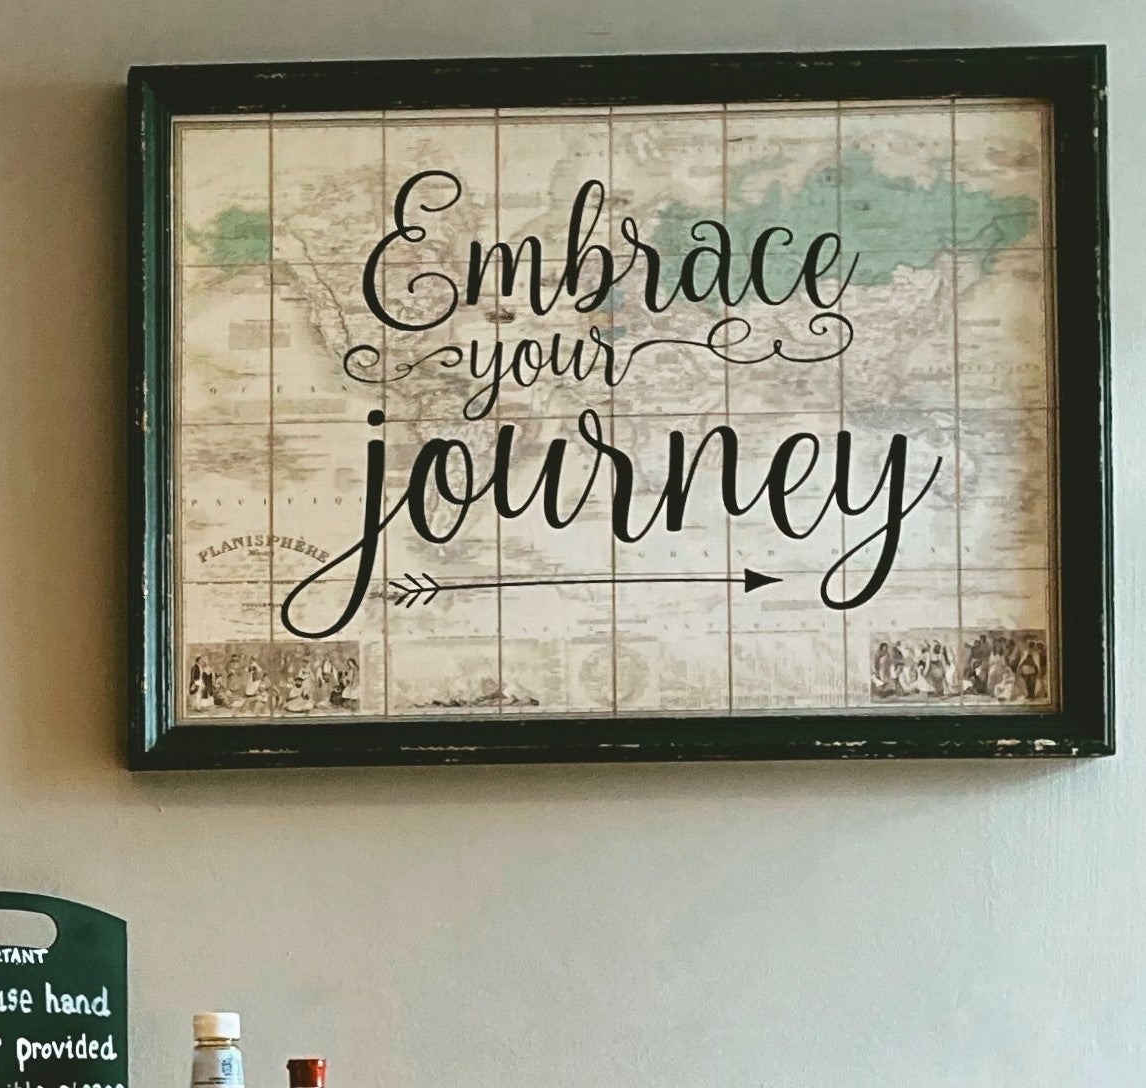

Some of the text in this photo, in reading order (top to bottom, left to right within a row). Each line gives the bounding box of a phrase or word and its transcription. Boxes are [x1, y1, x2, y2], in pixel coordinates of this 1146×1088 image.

[363, 170, 859, 331] Embrace
[281, 409, 943, 639] journey
[198, 534, 331, 564] PLANISPHÈRE
[45, 981, 112, 1018] hand
[17, 1034, 118, 1072] provided
